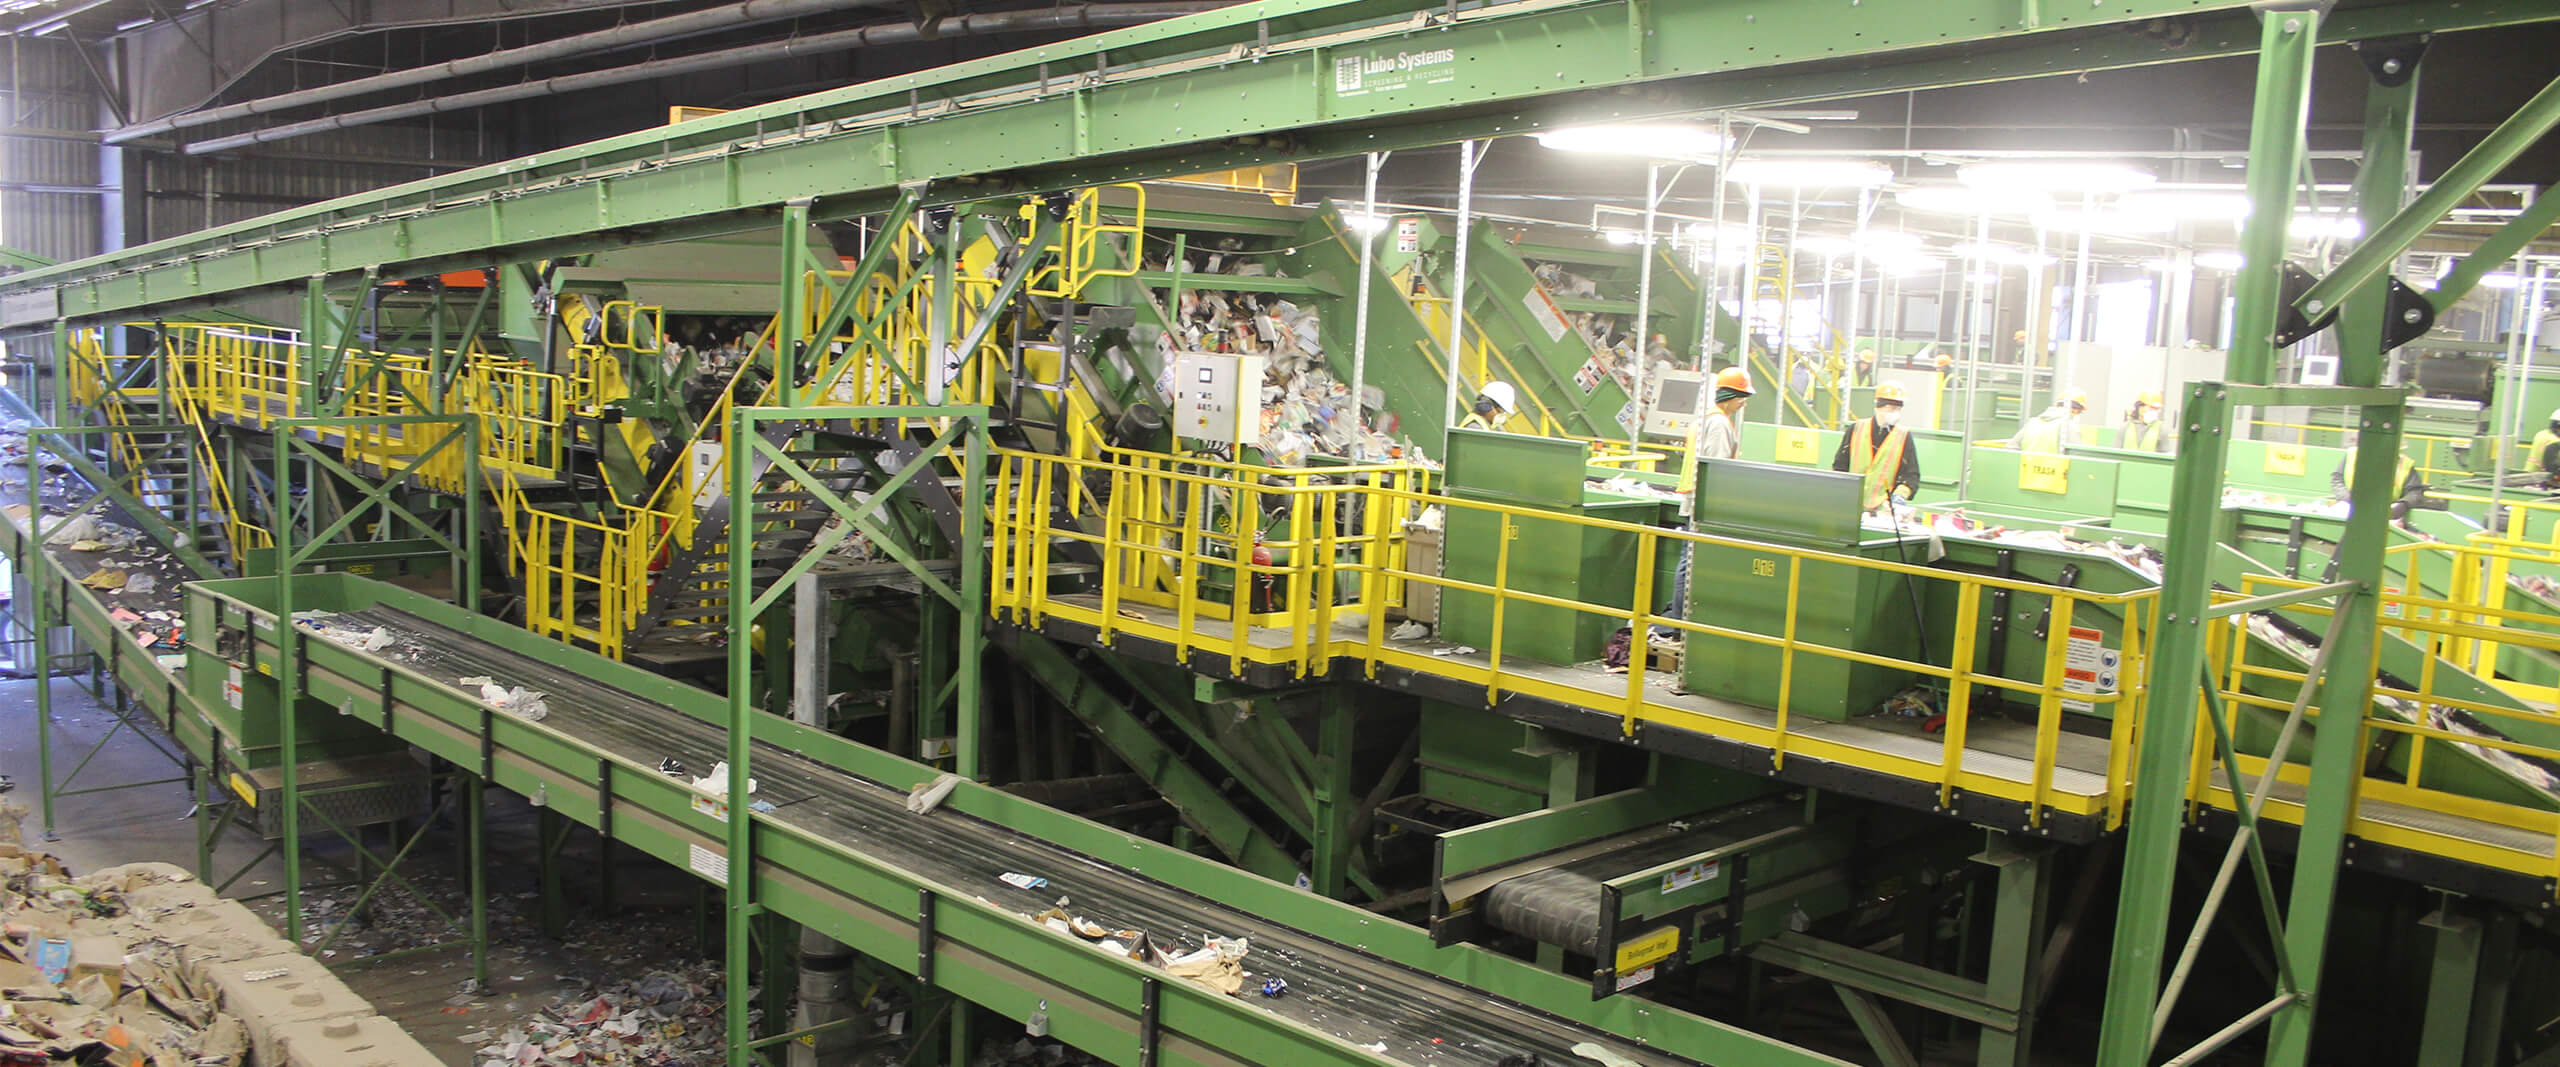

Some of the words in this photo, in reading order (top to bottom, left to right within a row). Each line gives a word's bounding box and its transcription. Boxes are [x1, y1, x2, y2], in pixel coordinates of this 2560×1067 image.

[1363, 55, 1395, 74] Lubo
[1398, 48, 1454, 72] Systems
[2032, 464, 2056, 476] TRASH
